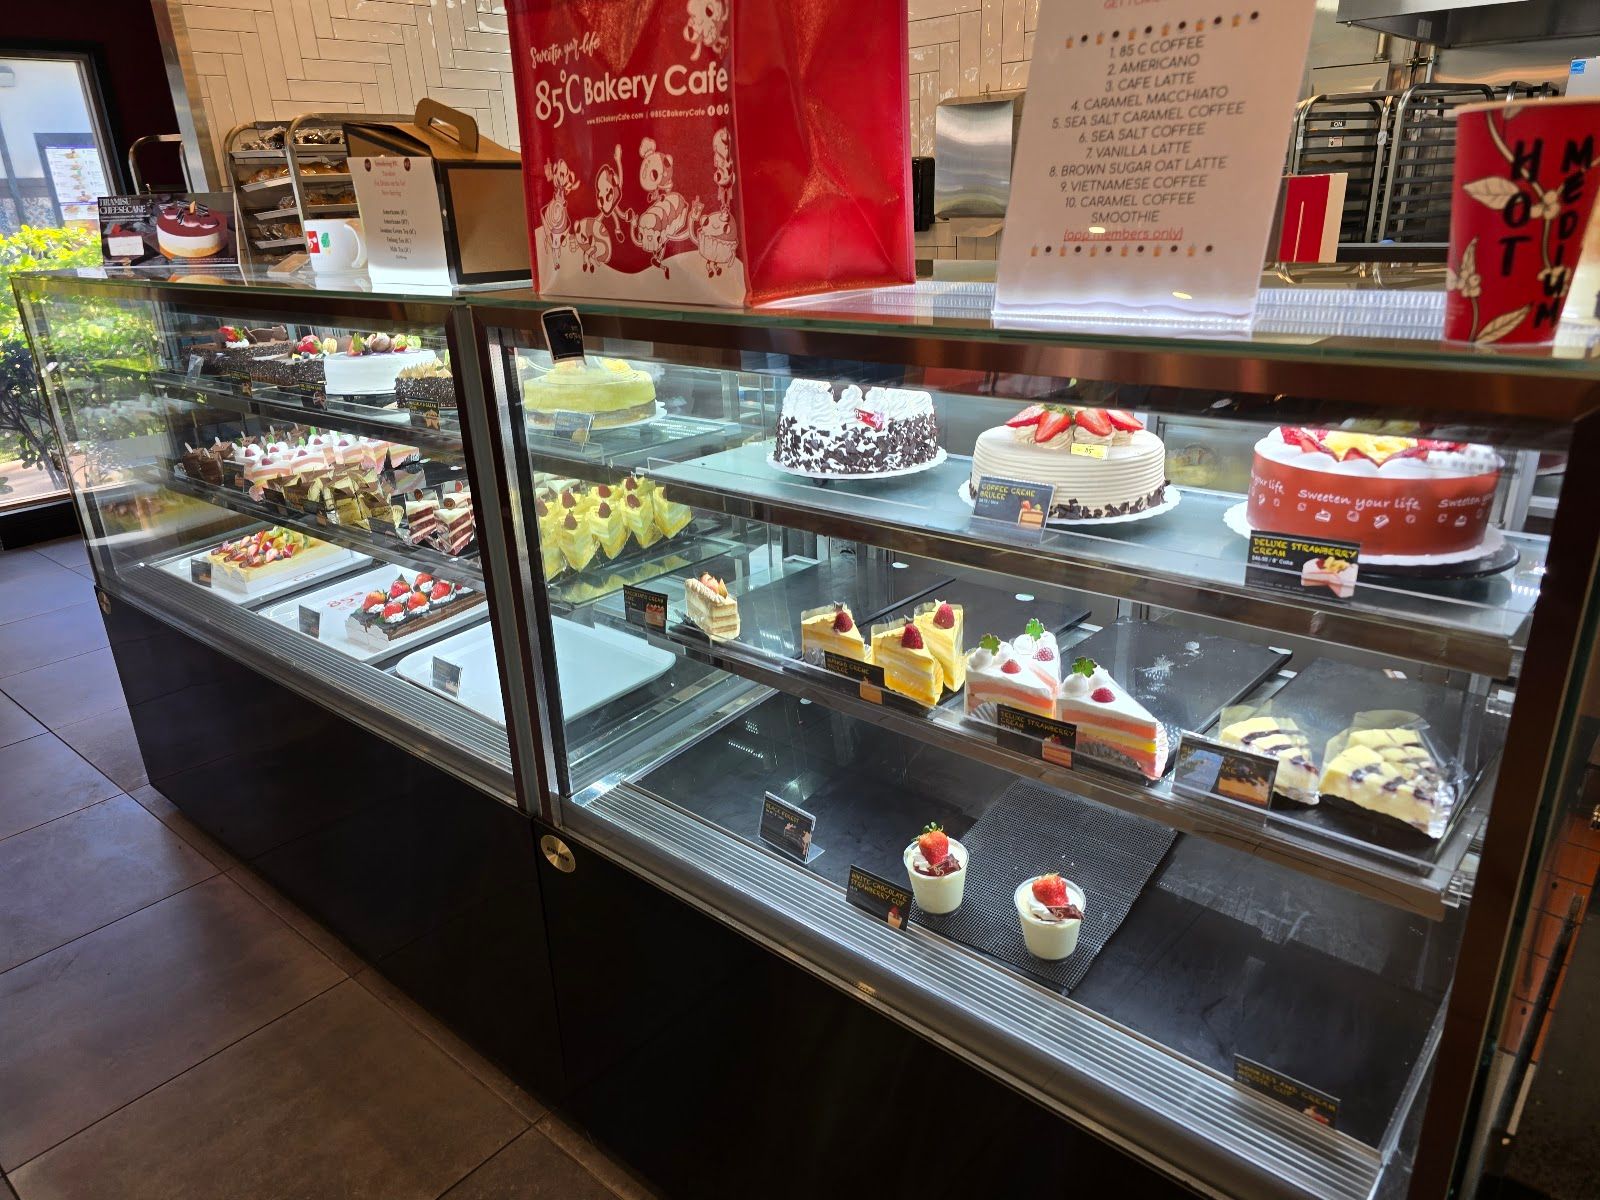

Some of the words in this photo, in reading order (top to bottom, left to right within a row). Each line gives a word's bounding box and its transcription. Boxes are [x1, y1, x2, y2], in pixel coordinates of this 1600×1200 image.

[1120, 44, 1134, 57] 85
[1137, 43, 1147, 55] C
[1150, 35, 1205, 54] COFFEE
[1120, 53, 1200, 74] AMERICANO
[583, 71, 658, 105] Bakery
[664, 61, 729, 96] Cafe
[1118, 76, 1151, 91] CAFE
[1154, 71, 1196, 88] LATTE
[1071, 100, 1080, 111] 4.
[1084, 95, 1142, 111] CARAMEL
[1146, 85, 1229, 103] MACCHIATO
[1065, 115, 1087, 128] SEA
[1091, 112, 1119, 127] SALT
[1122, 107, 1183, 124] CARAMEL
[1188, 101, 1246, 118] COFFEE
[1091, 130, 1114, 142] SEA
[1118, 127, 1149, 141] SALT
[1151, 123, 1206, 138] COFFEE
[1096, 144, 1147, 158] VANILLA
[1150, 140, 1192, 155] LATTE
[1061, 163, 1105, 176] BROWN
[1108, 160, 1150, 174] SUGAR
[1154, 158, 1181, 172] OAT
[1185, 155, 1228, 170] LATTE
[1071, 177, 1150, 192] VIETNAMESE
[1153, 174, 1208, 189] COFFEE
[1065, 197, 1077, 208] 10.
[1081, 195, 1137, 208] CARAMEL
[1142, 191, 1196, 206] COFFEE
[1500, 137, 1544, 277] HOT
[1091, 210, 1160, 224] SMOOTHIE
[1092, 227, 1149, 241] members
[1533, 134, 1594, 329] MEDIUM
[981, 483, 1009, 494] COFFEE
[1269, 480, 1285, 494] life
[1298, 489, 1351, 504] Sweeten
[1355, 498, 1391, 511] your
[1394, 497, 1421, 511] life
[1438, 498, 1480, 508] Sweeten
[1253, 538, 1288, 549] DELUXE
[1292, 542, 1358, 558] STRAWBERRY
[1253, 547, 1286, 558] CREAM
[1027, 719, 1075, 737] STRAWBERRY
[872, 882, 908, 902] CHOCOLATE
